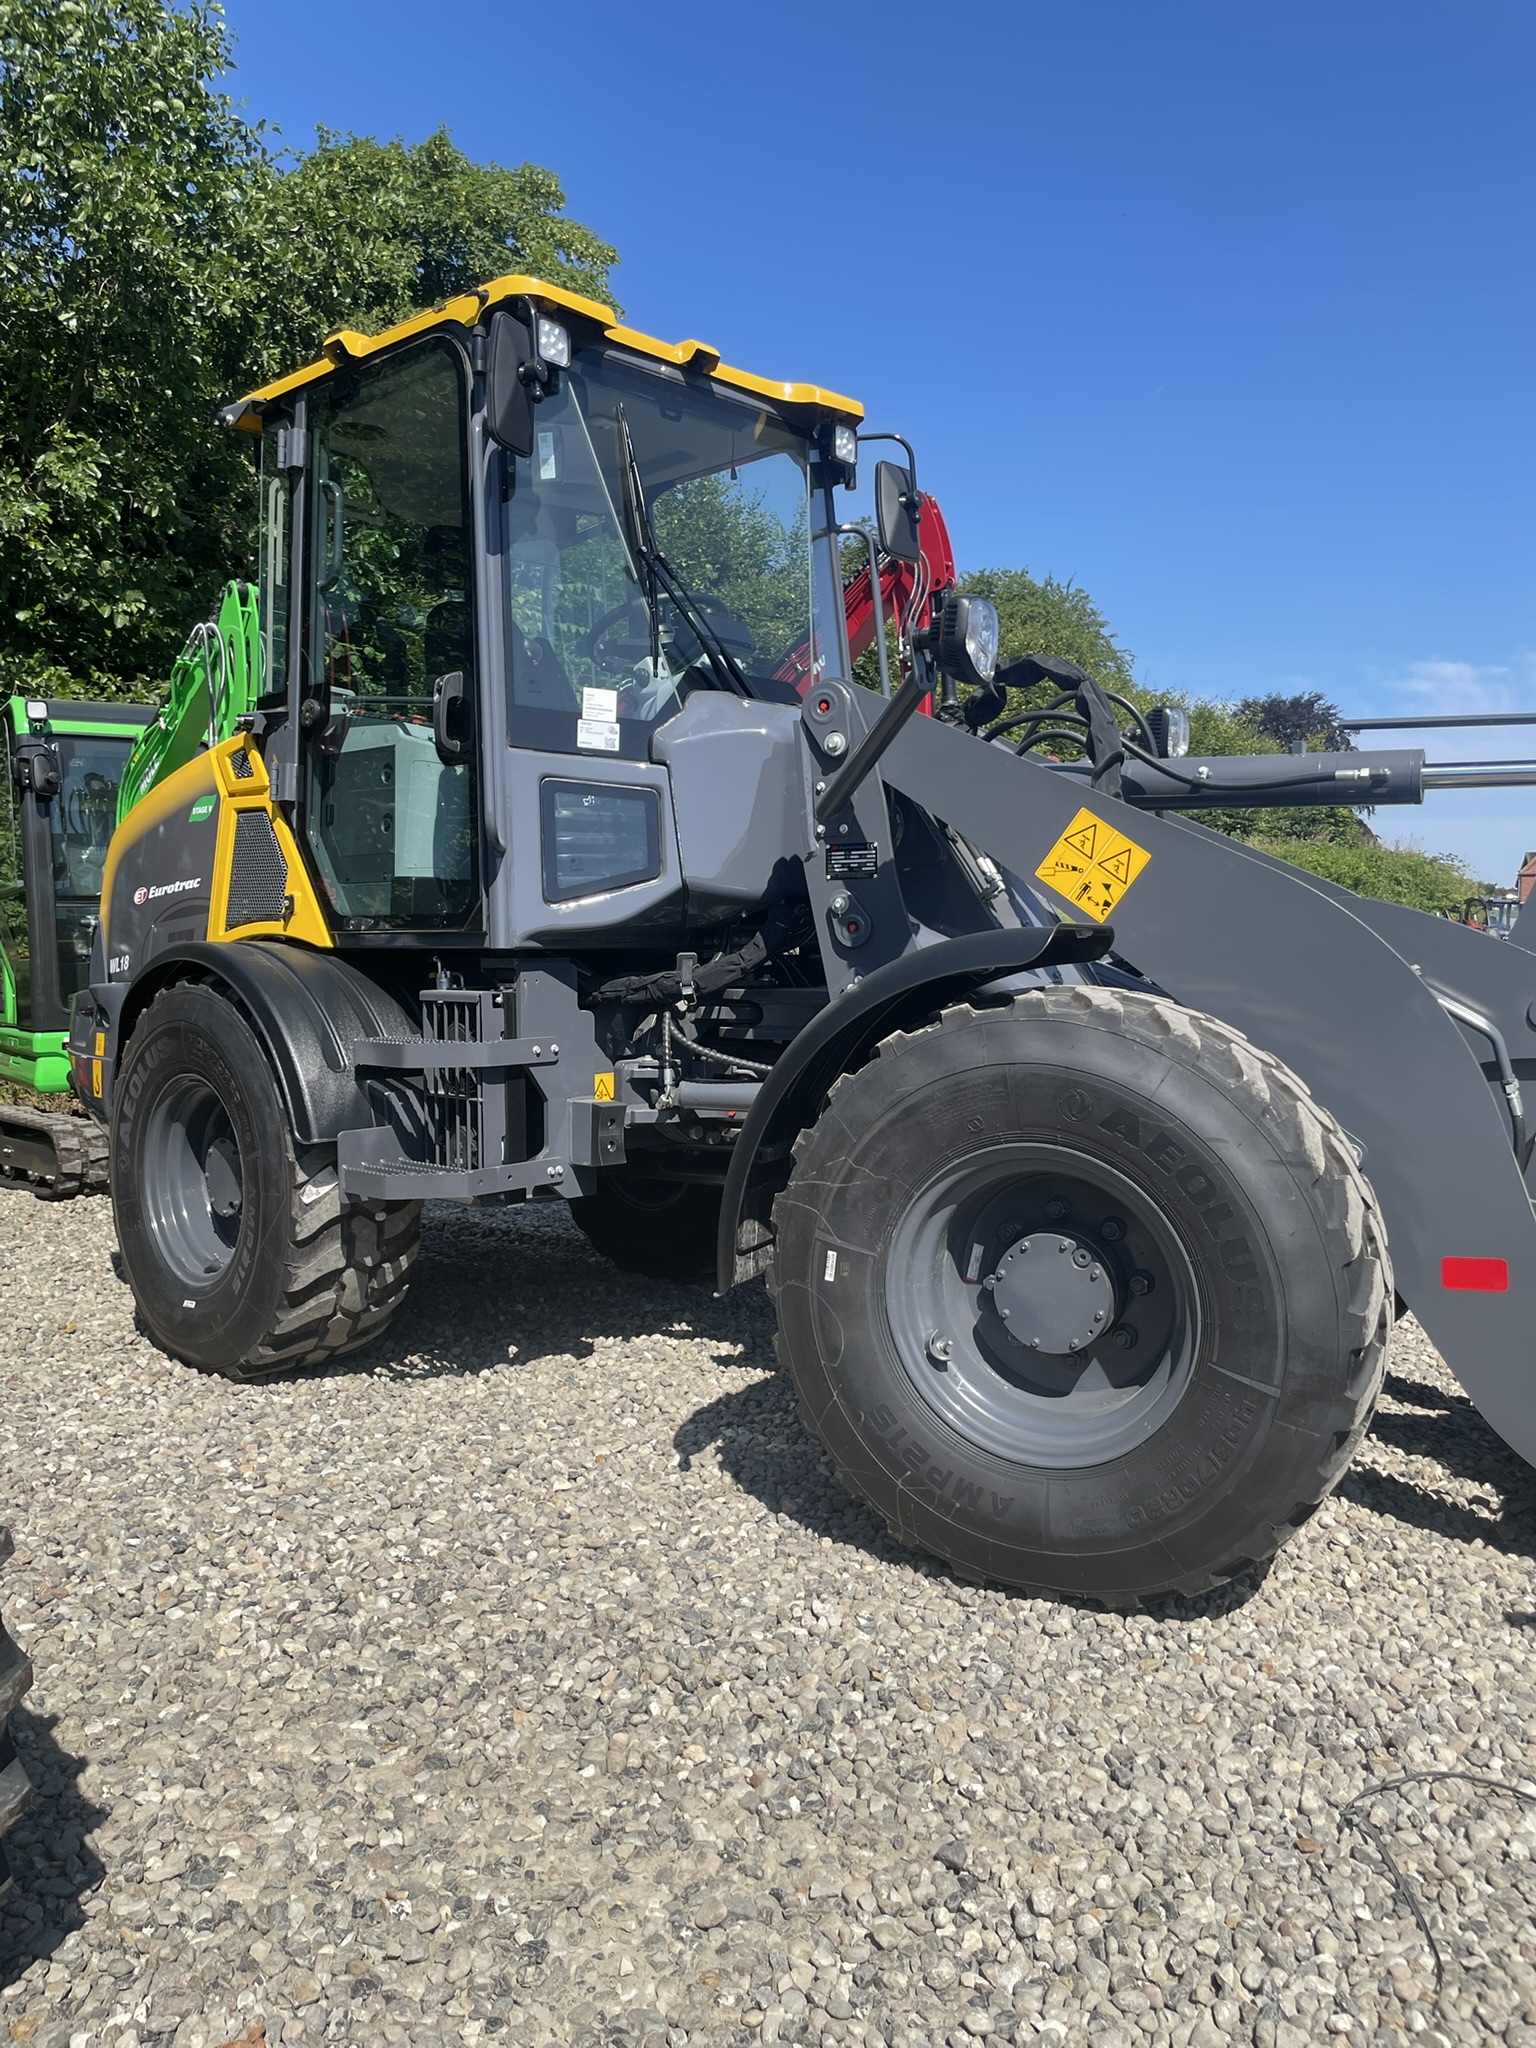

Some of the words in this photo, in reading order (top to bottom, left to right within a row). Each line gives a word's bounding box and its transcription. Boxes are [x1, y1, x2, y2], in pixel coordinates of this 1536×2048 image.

[192, 805, 208, 815] STAGE
[148, 878, 202, 899] Eurotrac
[110, 955, 130, 974] WL18
[120, 1036, 172, 1149] AEOLUS
[1097, 1107, 1266, 1333] AEOLUS
[867, 1403, 1015, 1520] AMP215
